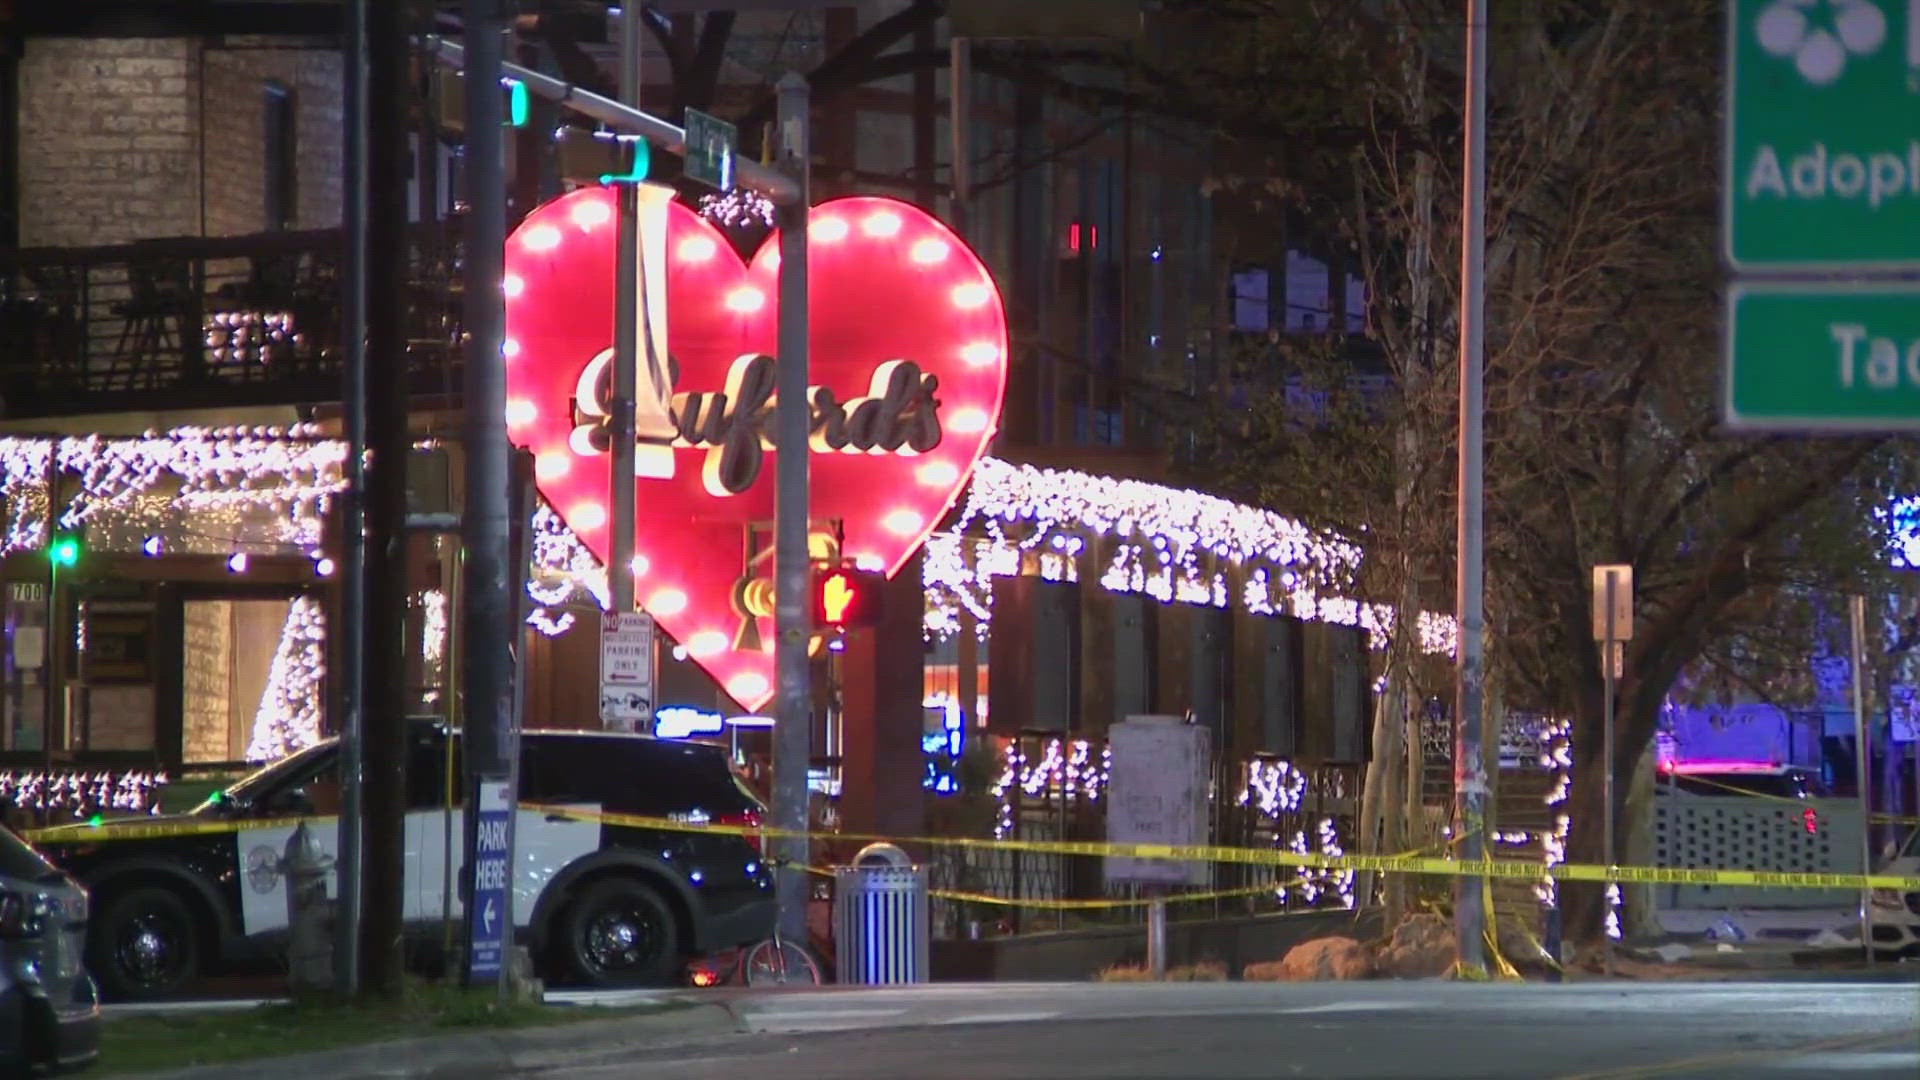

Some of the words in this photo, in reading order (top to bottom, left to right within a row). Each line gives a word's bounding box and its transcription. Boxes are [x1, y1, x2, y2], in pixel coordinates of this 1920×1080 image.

[15, 584, 41, 600] 700
[604, 613, 618, 628] NO
[606, 646, 647, 656] PARKING
[614, 660, 639, 670] ONLY
[478, 821, 507, 851] PARK
[475, 858, 506, 890] HERE
[1460, 862, 1486, 874] POLICE
